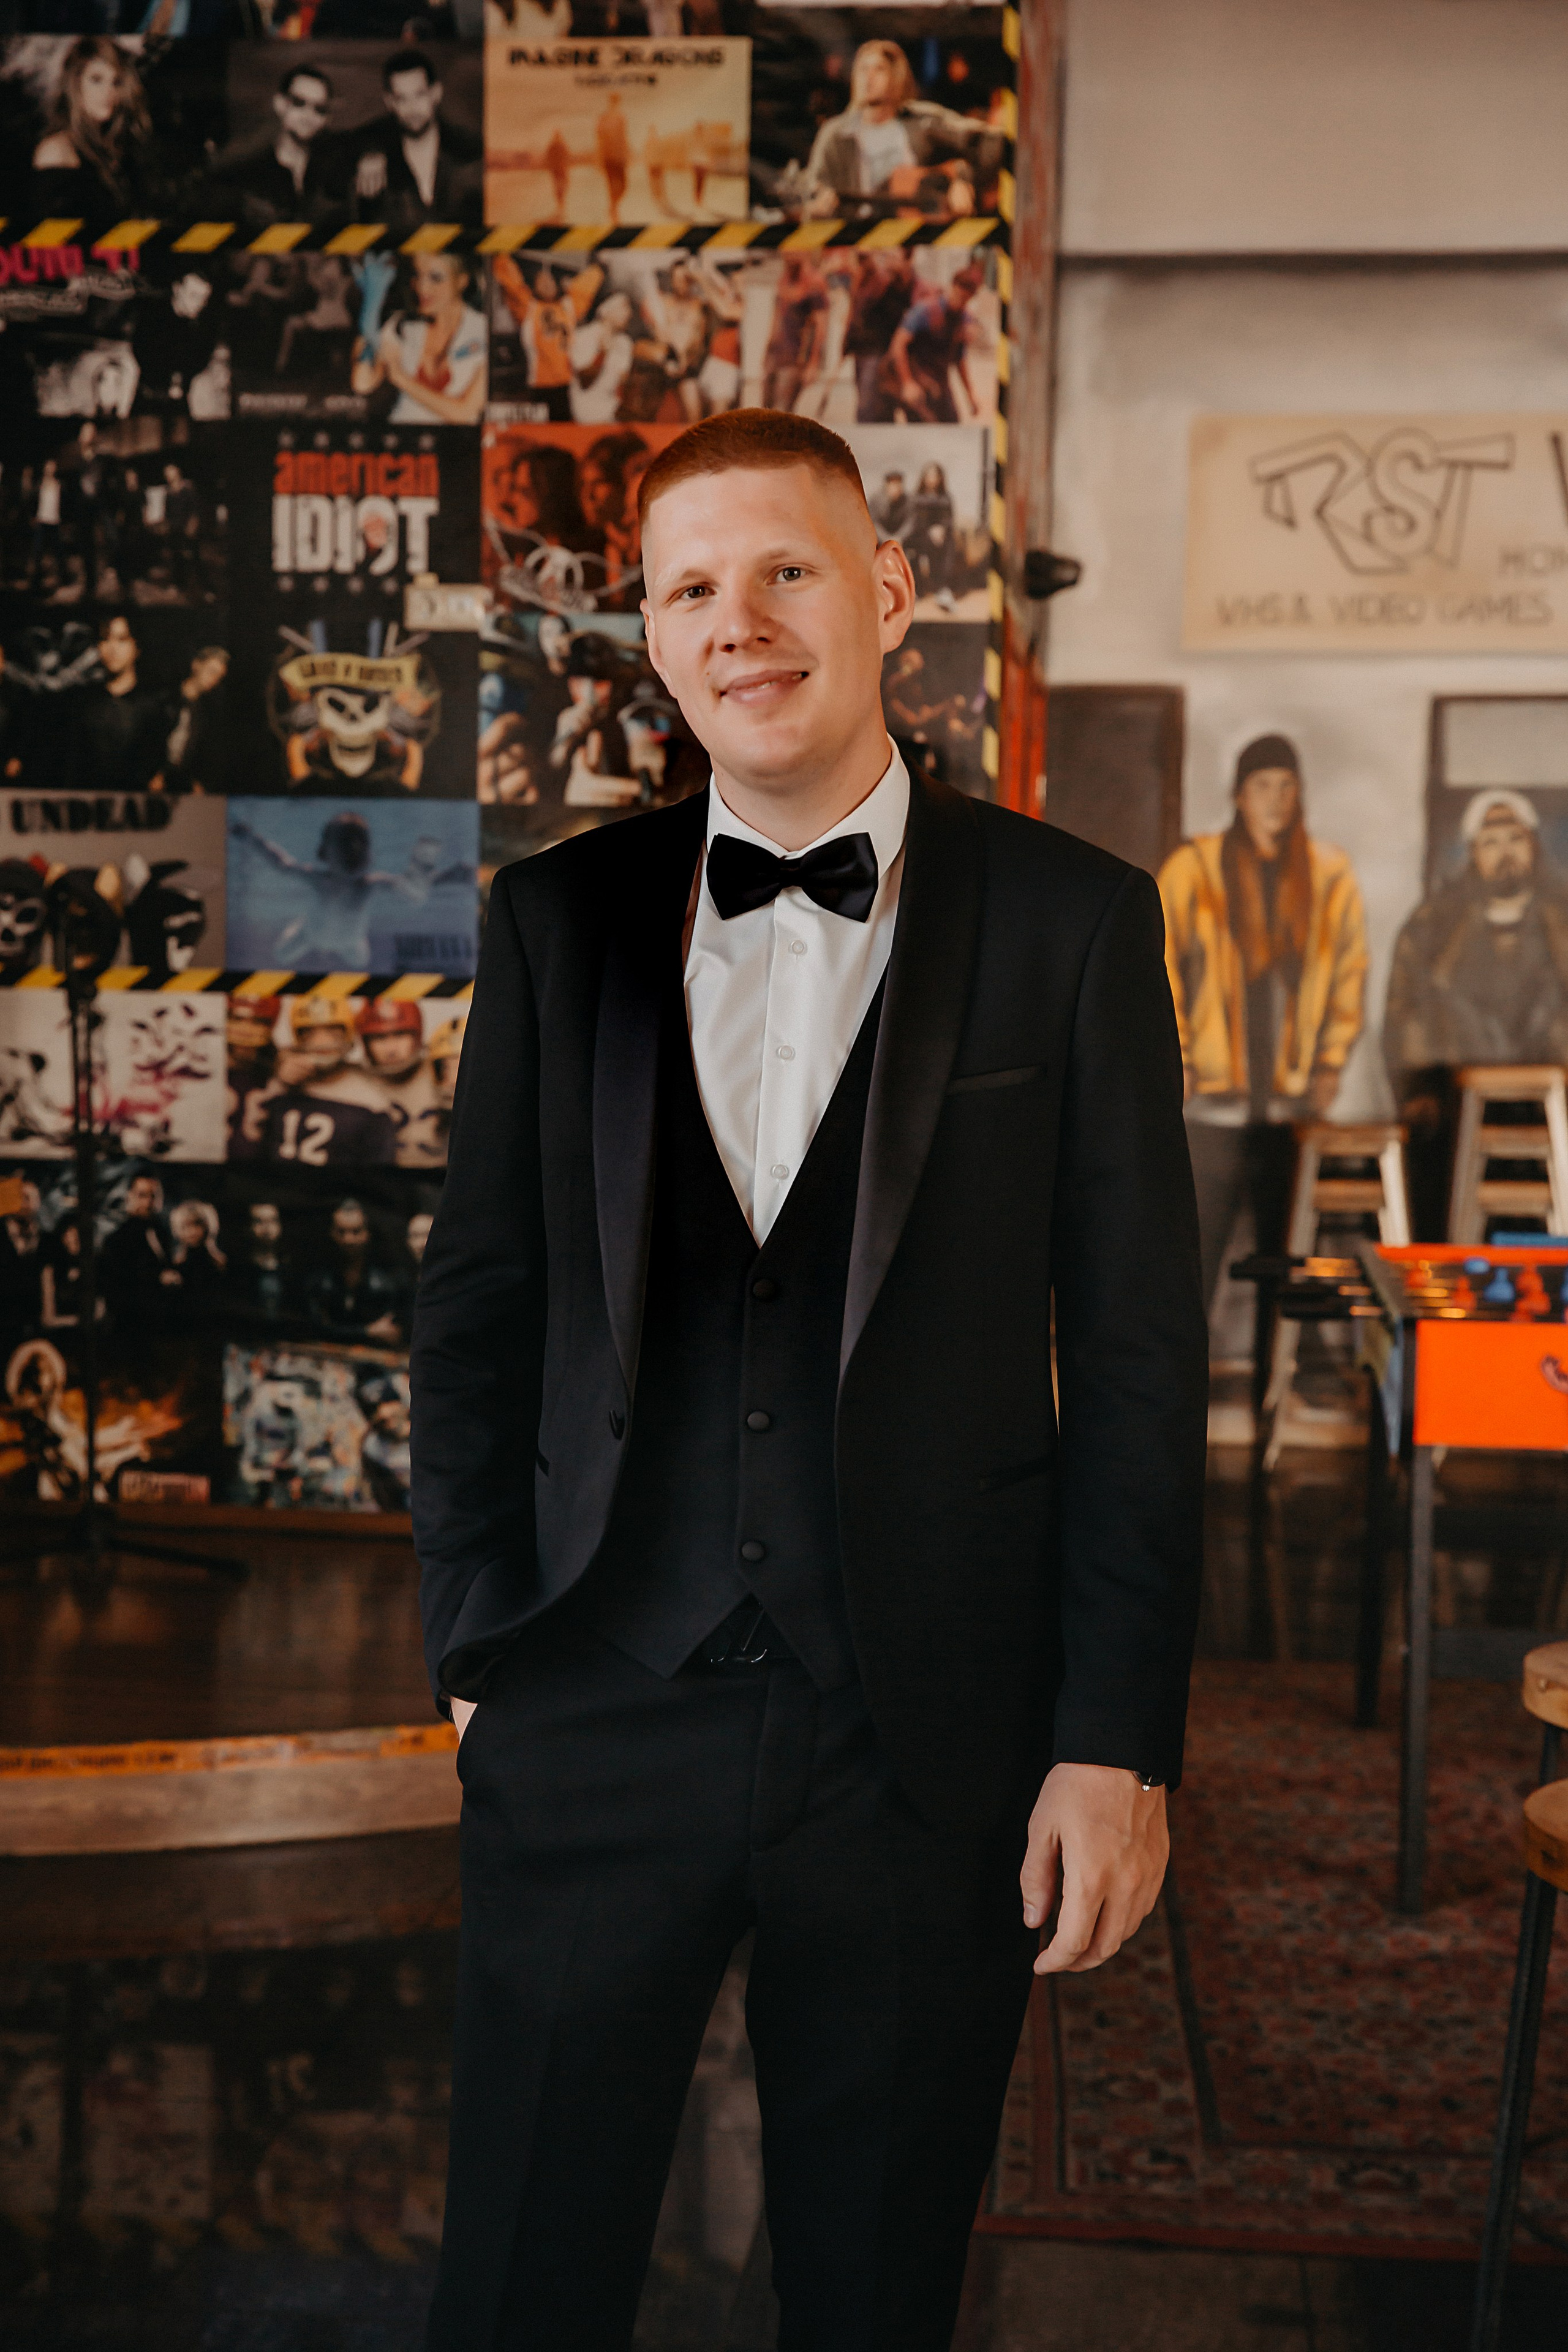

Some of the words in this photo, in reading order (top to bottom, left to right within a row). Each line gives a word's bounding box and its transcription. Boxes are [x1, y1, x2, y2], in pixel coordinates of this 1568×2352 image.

[273, 451, 440, 497] american
[271, 494, 440, 576] IDIOT
[279, 1109, 335, 1167] 12
